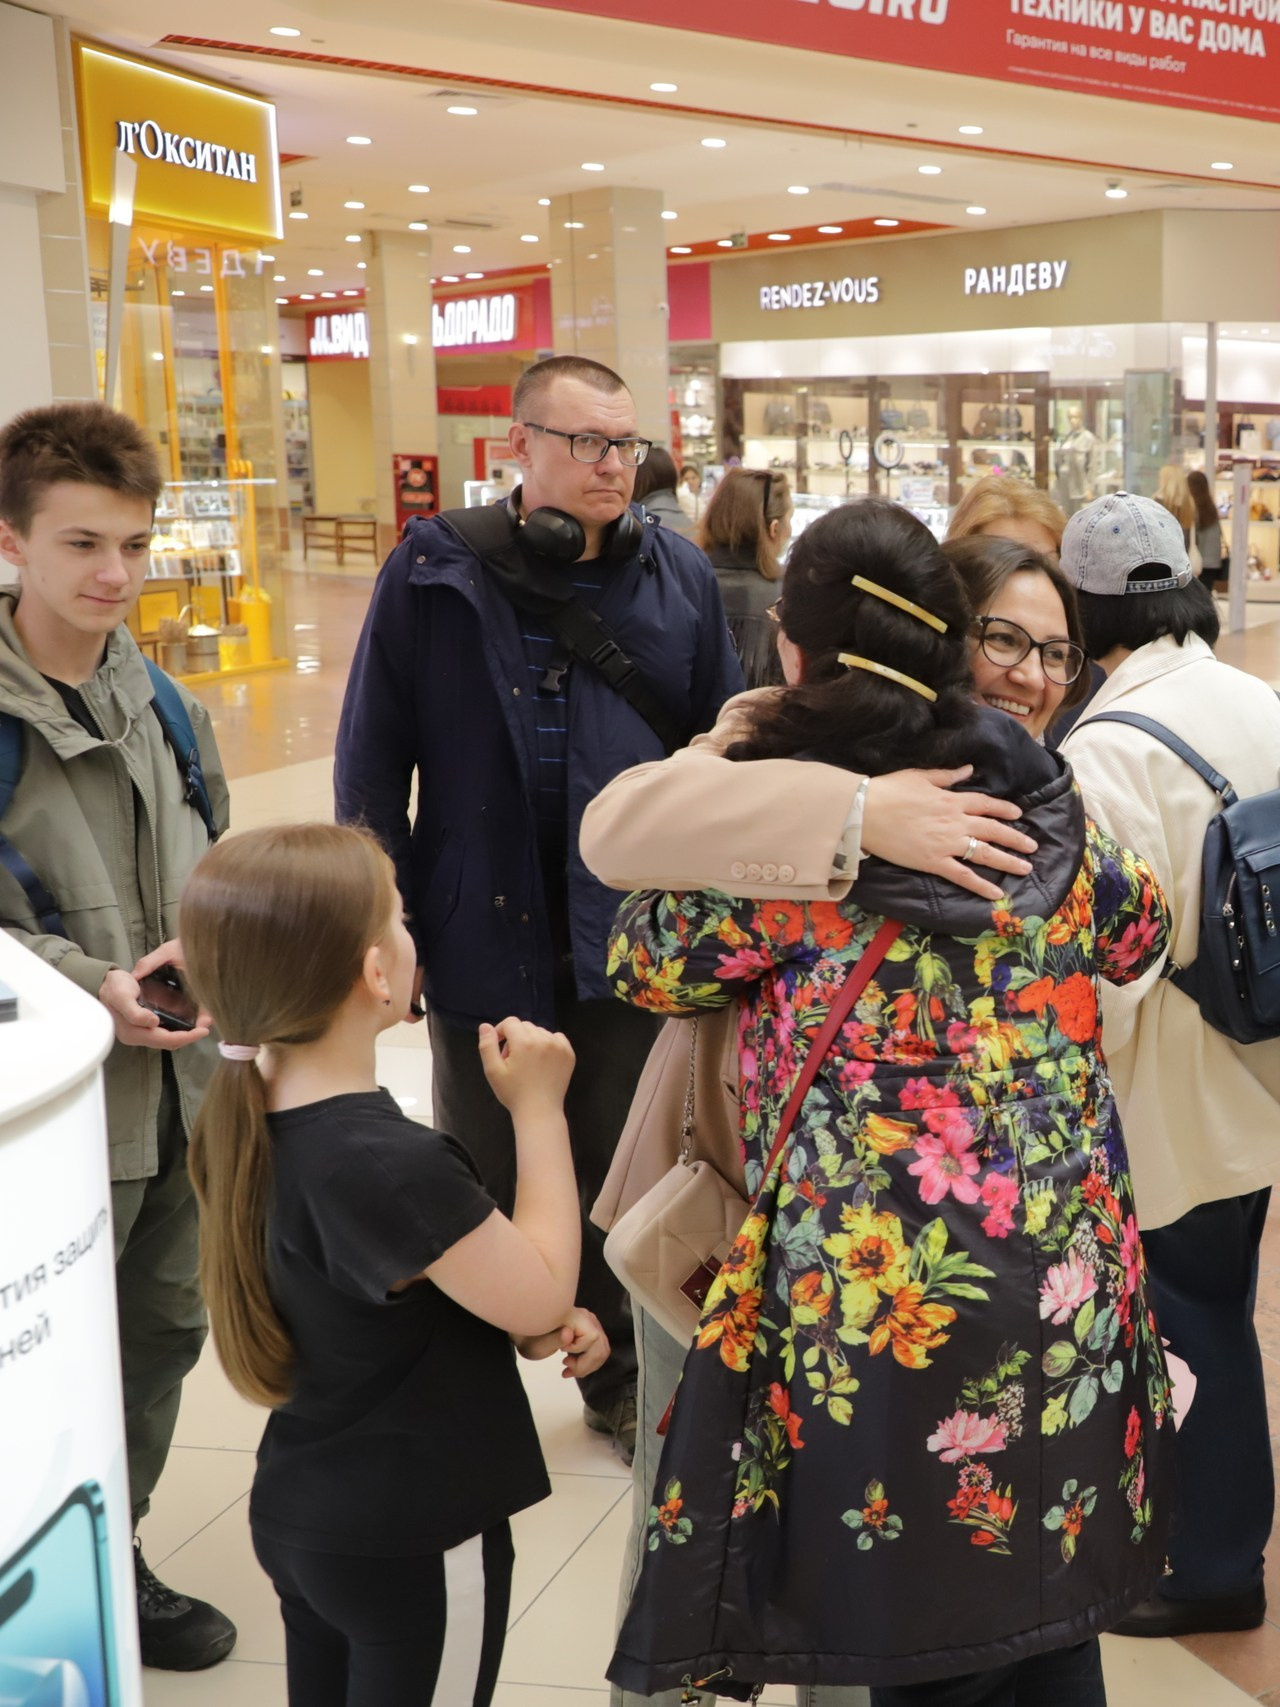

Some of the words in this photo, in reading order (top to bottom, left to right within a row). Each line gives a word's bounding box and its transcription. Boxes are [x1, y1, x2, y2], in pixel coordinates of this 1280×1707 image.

[1006, 28, 1068, 55] Гарантия
[1070, 43, 1087, 57] на
[1089, 46, 1113, 61] все
[1114, 51, 1148, 67] виды
[1149, 54, 1187, 73] работ
[1128, 5, 1146, 35] У
[1149, 9, 1195, 45] ВАС
[1198, 19, 1266, 58] ДОМА
[760, 277, 879, 310] RENDEZ-VOUS
[964, 260, 1067, 296] РАНДЕВУ
[432, 293, 515, 348] ЬДОРАДО
